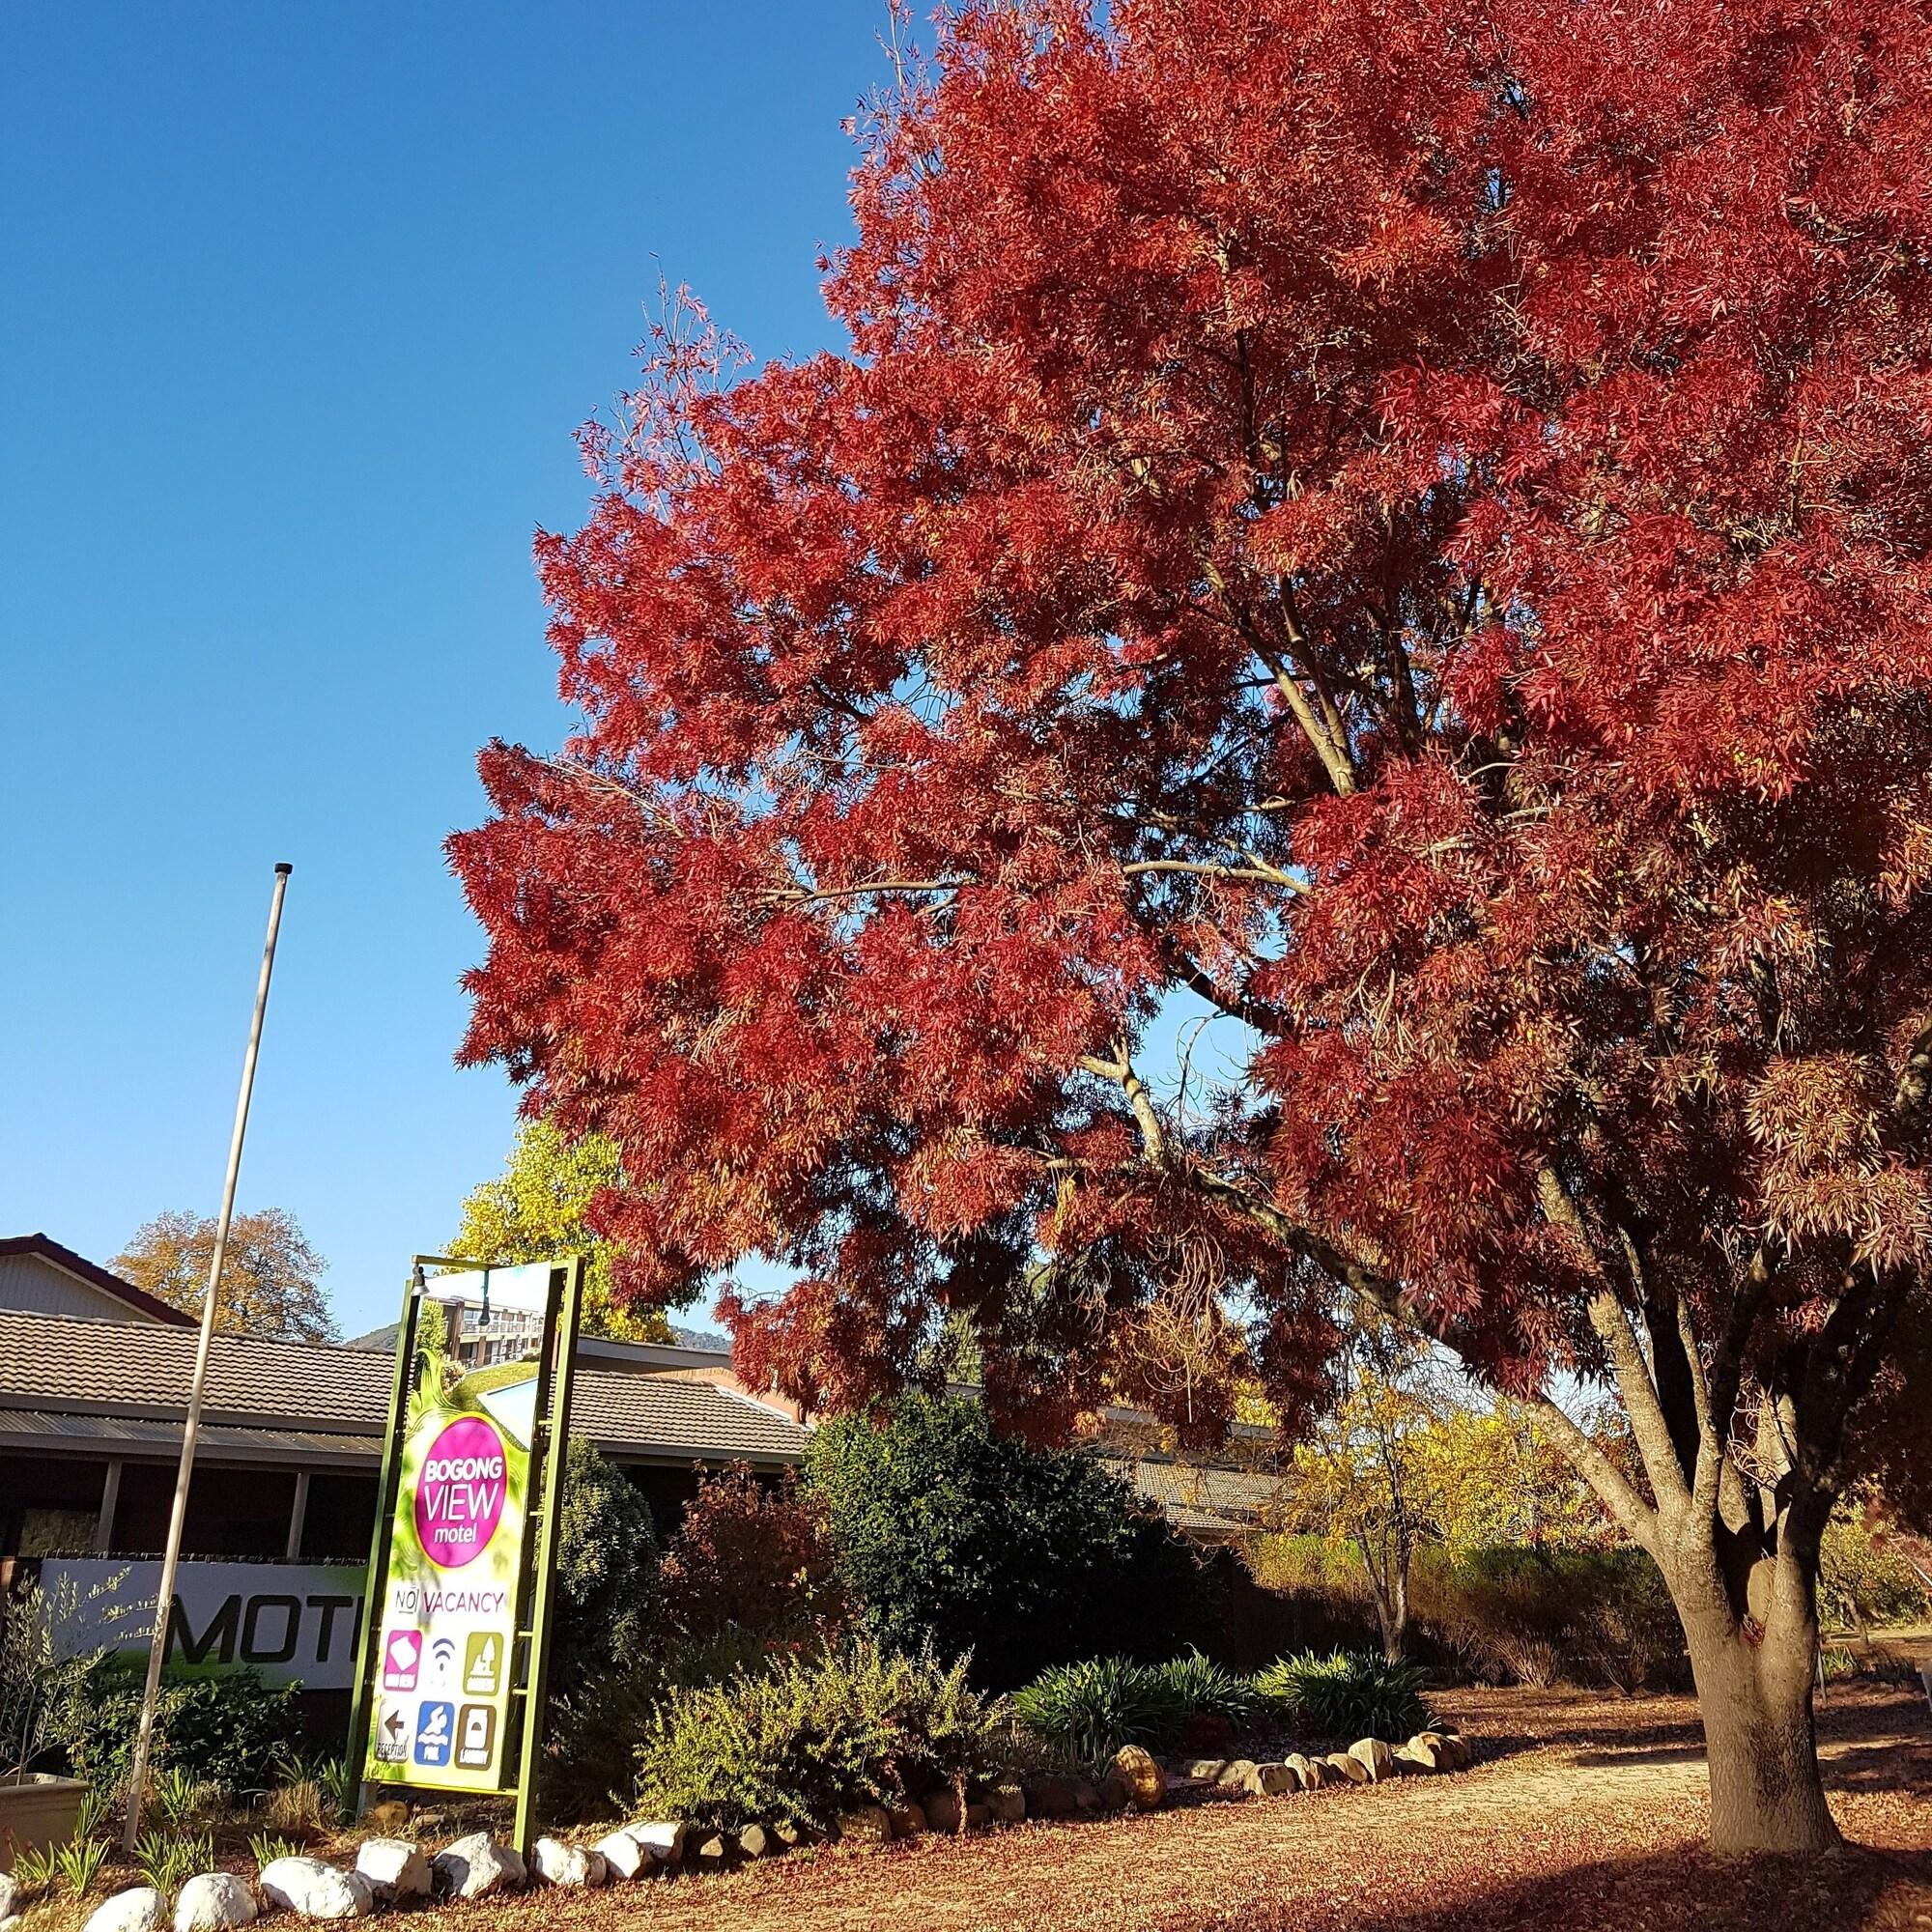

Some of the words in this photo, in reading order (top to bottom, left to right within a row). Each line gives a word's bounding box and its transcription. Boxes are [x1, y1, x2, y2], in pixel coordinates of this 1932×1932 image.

[424, 1456, 503, 1483] BOGONG
[423, 1483, 499, 1521] VIEW
[433, 1522, 477, 1544] motel
[395, 1589, 416, 1611] NO
[423, 1590, 505, 1613] VACANCY
[162, 1594, 365, 1664] MOT
